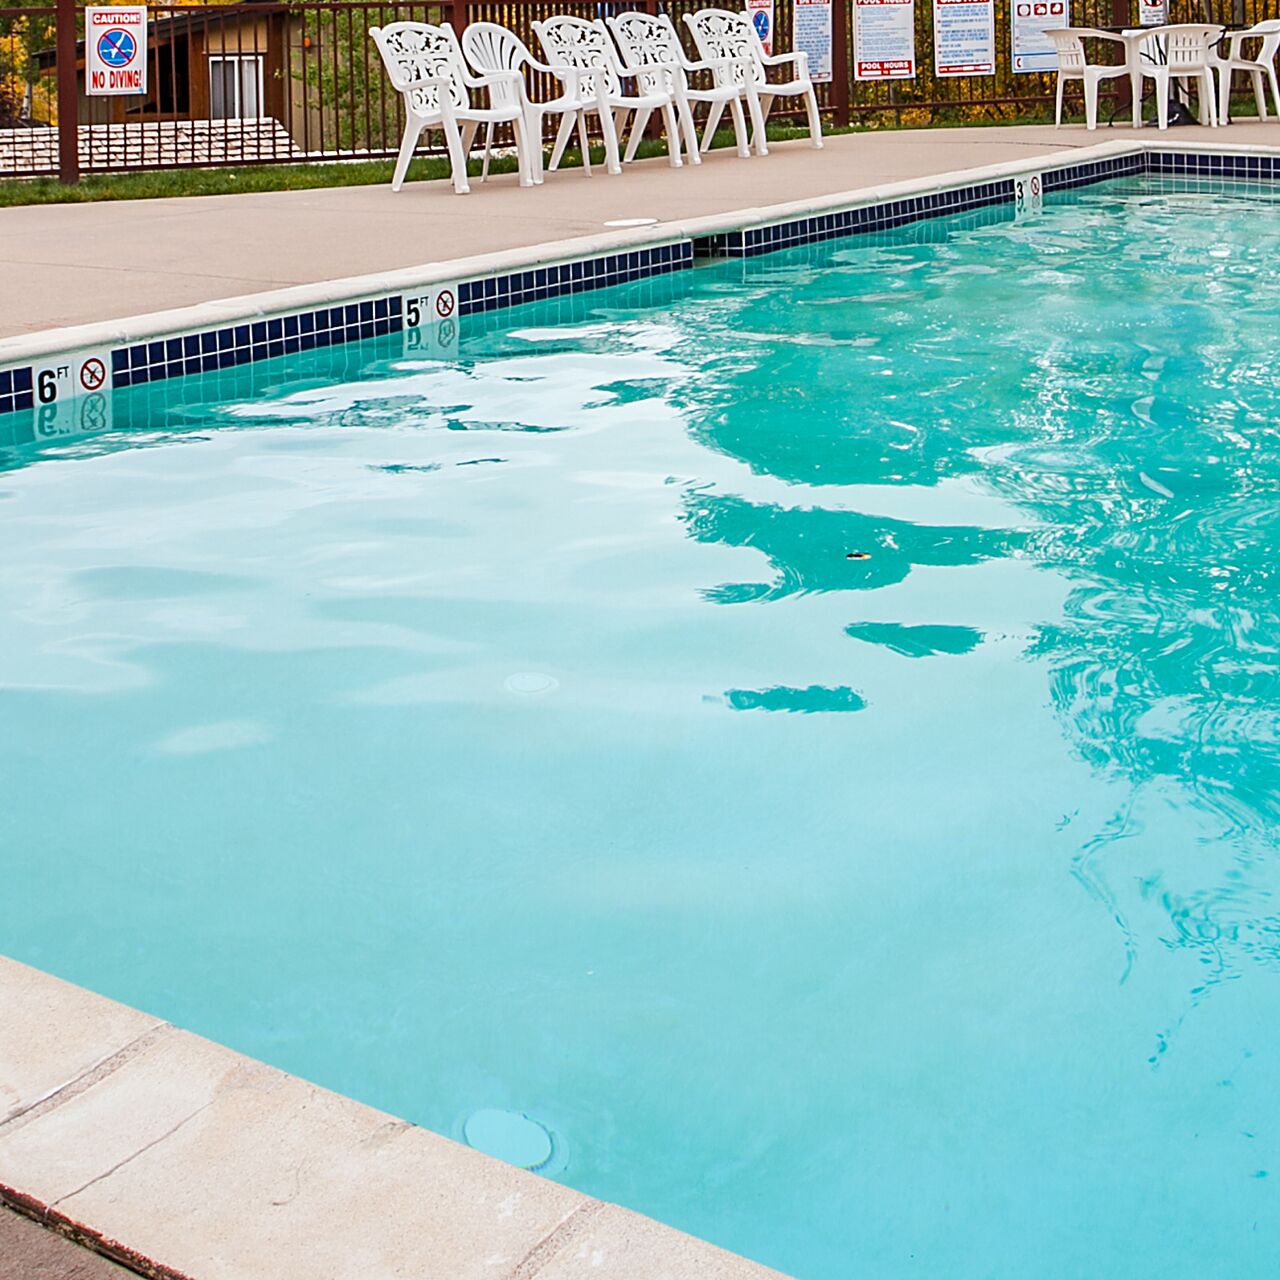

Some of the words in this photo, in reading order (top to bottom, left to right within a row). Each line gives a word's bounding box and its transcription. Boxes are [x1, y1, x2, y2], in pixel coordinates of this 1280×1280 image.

[94, 14, 140, 24] CAUTION!
[92, 71, 105, 89] NO
[110, 69, 142, 88] DIVING!
[1017, 181, 1023, 199] 3
[407, 298, 420, 327] 5
[420, 296, 429, 307] FT
[38, 370, 57, 403] 6
[57, 366, 69, 379] FT
